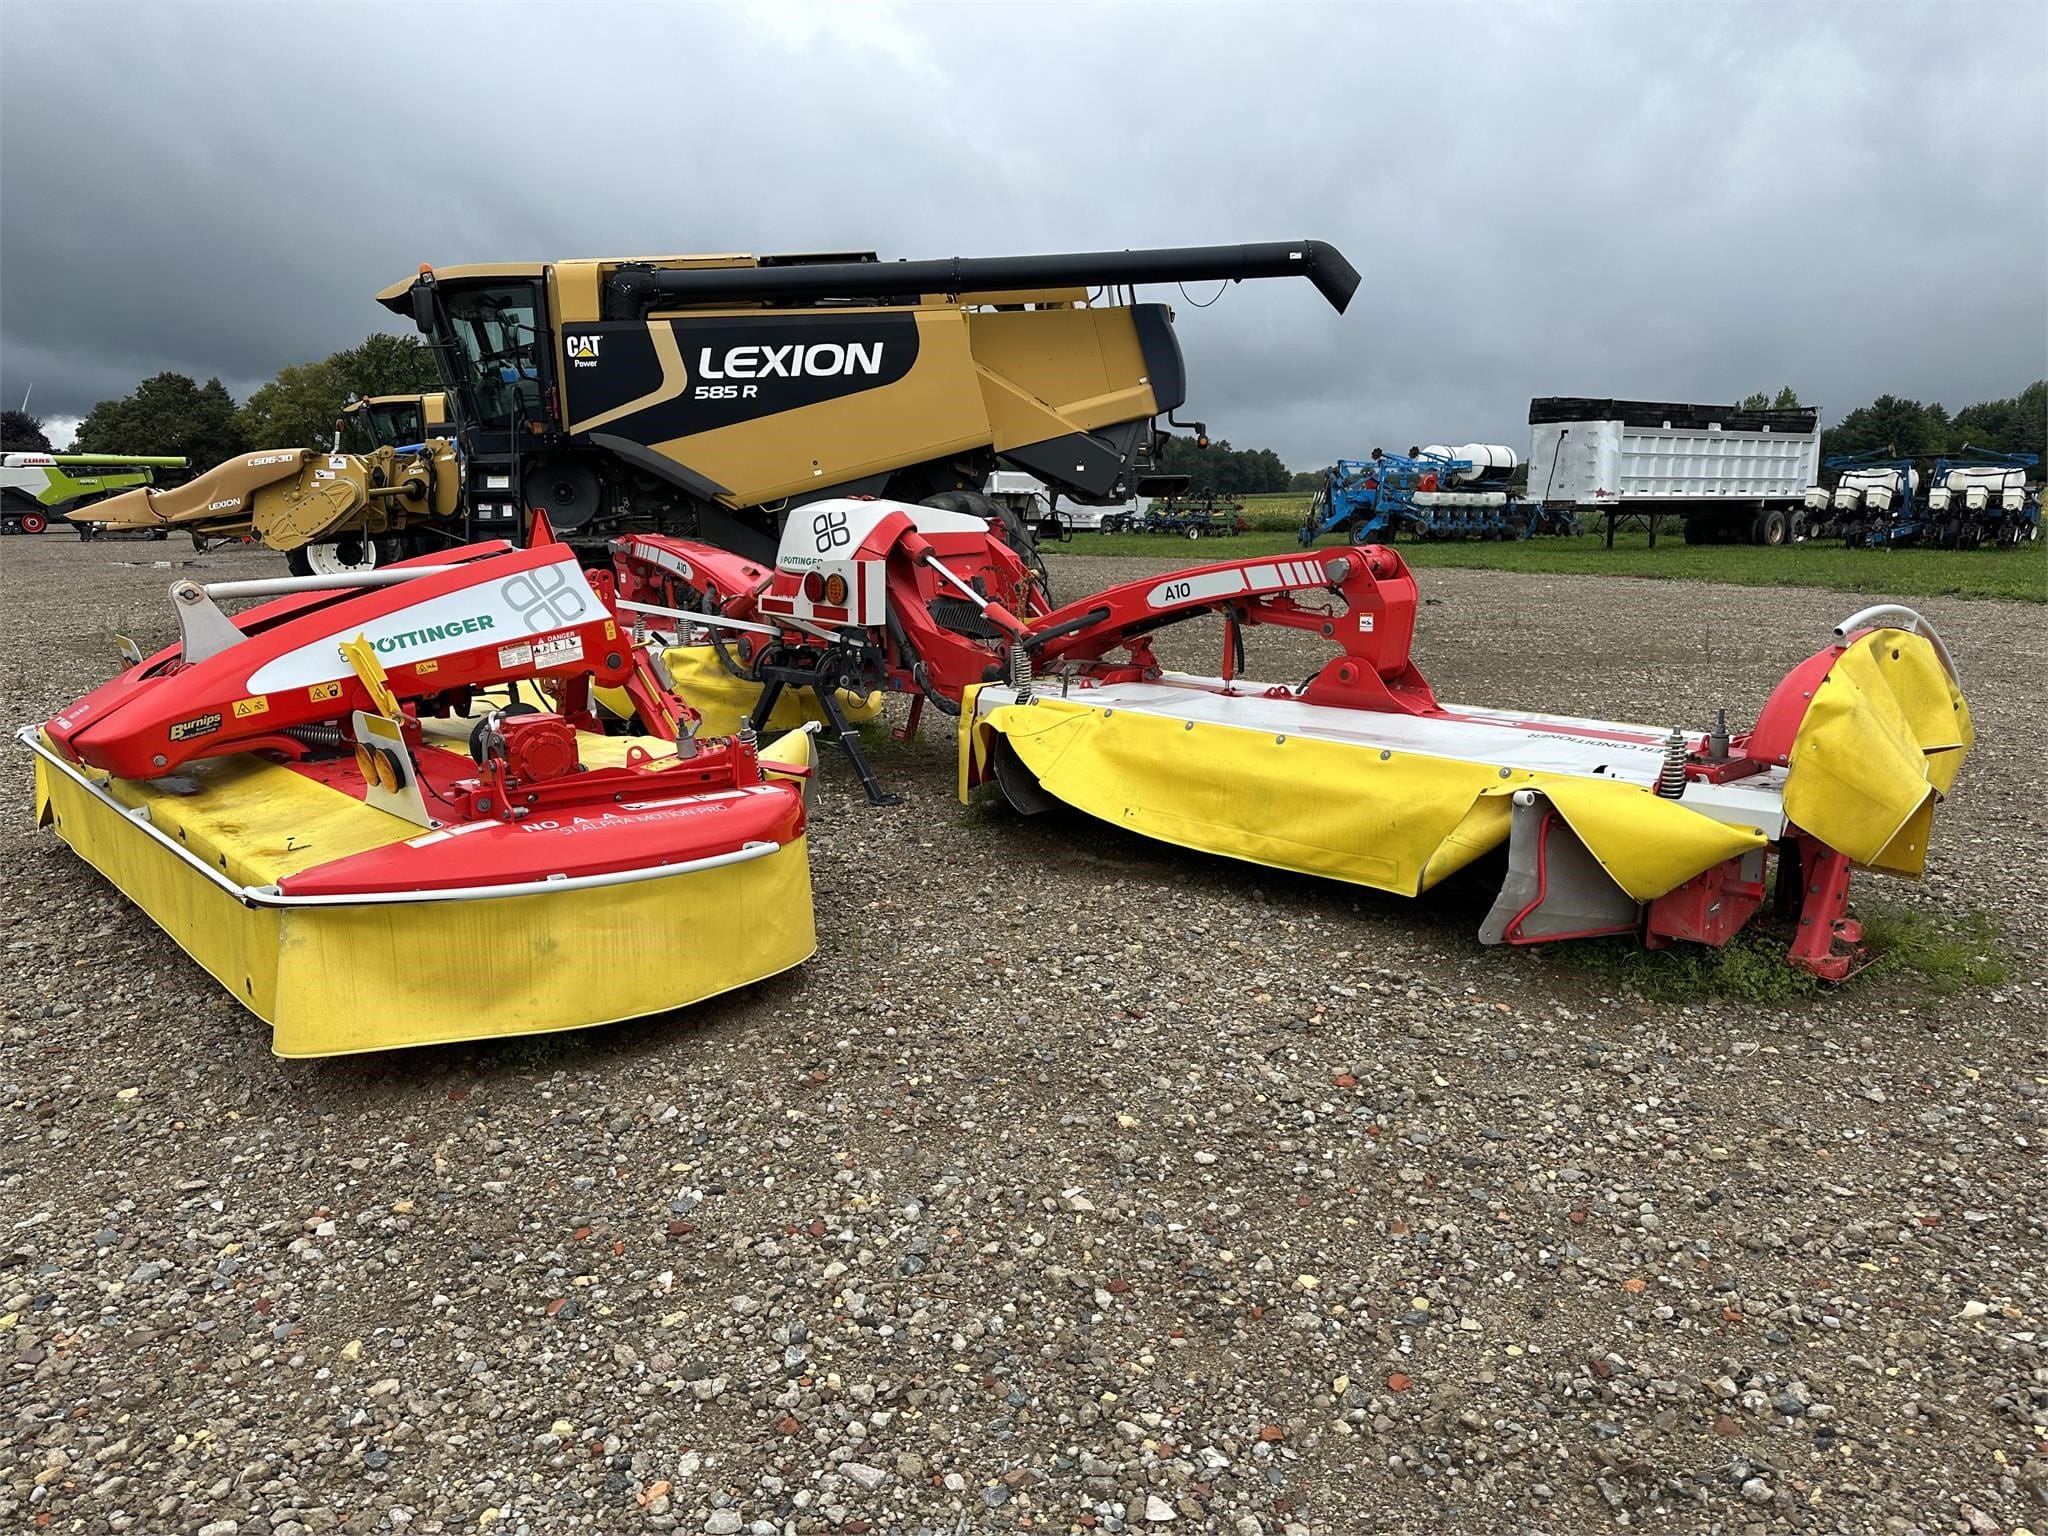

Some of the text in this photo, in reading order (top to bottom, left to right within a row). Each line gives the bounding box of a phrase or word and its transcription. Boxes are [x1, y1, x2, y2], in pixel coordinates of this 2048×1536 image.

[566, 335, 602, 358] CAT
[574, 359, 598, 368] Power
[699, 342, 884, 379] LEXION
[694, 384, 758, 400] 585 R
[247, 454, 294, 467] C506-30
[208, 498, 241, 511] LEXION
[676, 561, 688, 575] A10
[1165, 582, 1191, 601] A10
[369, 614, 495, 652] ÖTTINGER
[547, 631, 576, 642] DANGER
[170, 713, 222, 741] Burnips
[1527, 732, 1637, 750] CONDITIONER
[581, 816, 634, 833] ALPHA
[639, 809, 695, 823] MOTION
[698, 803, 728, 814] PRO
